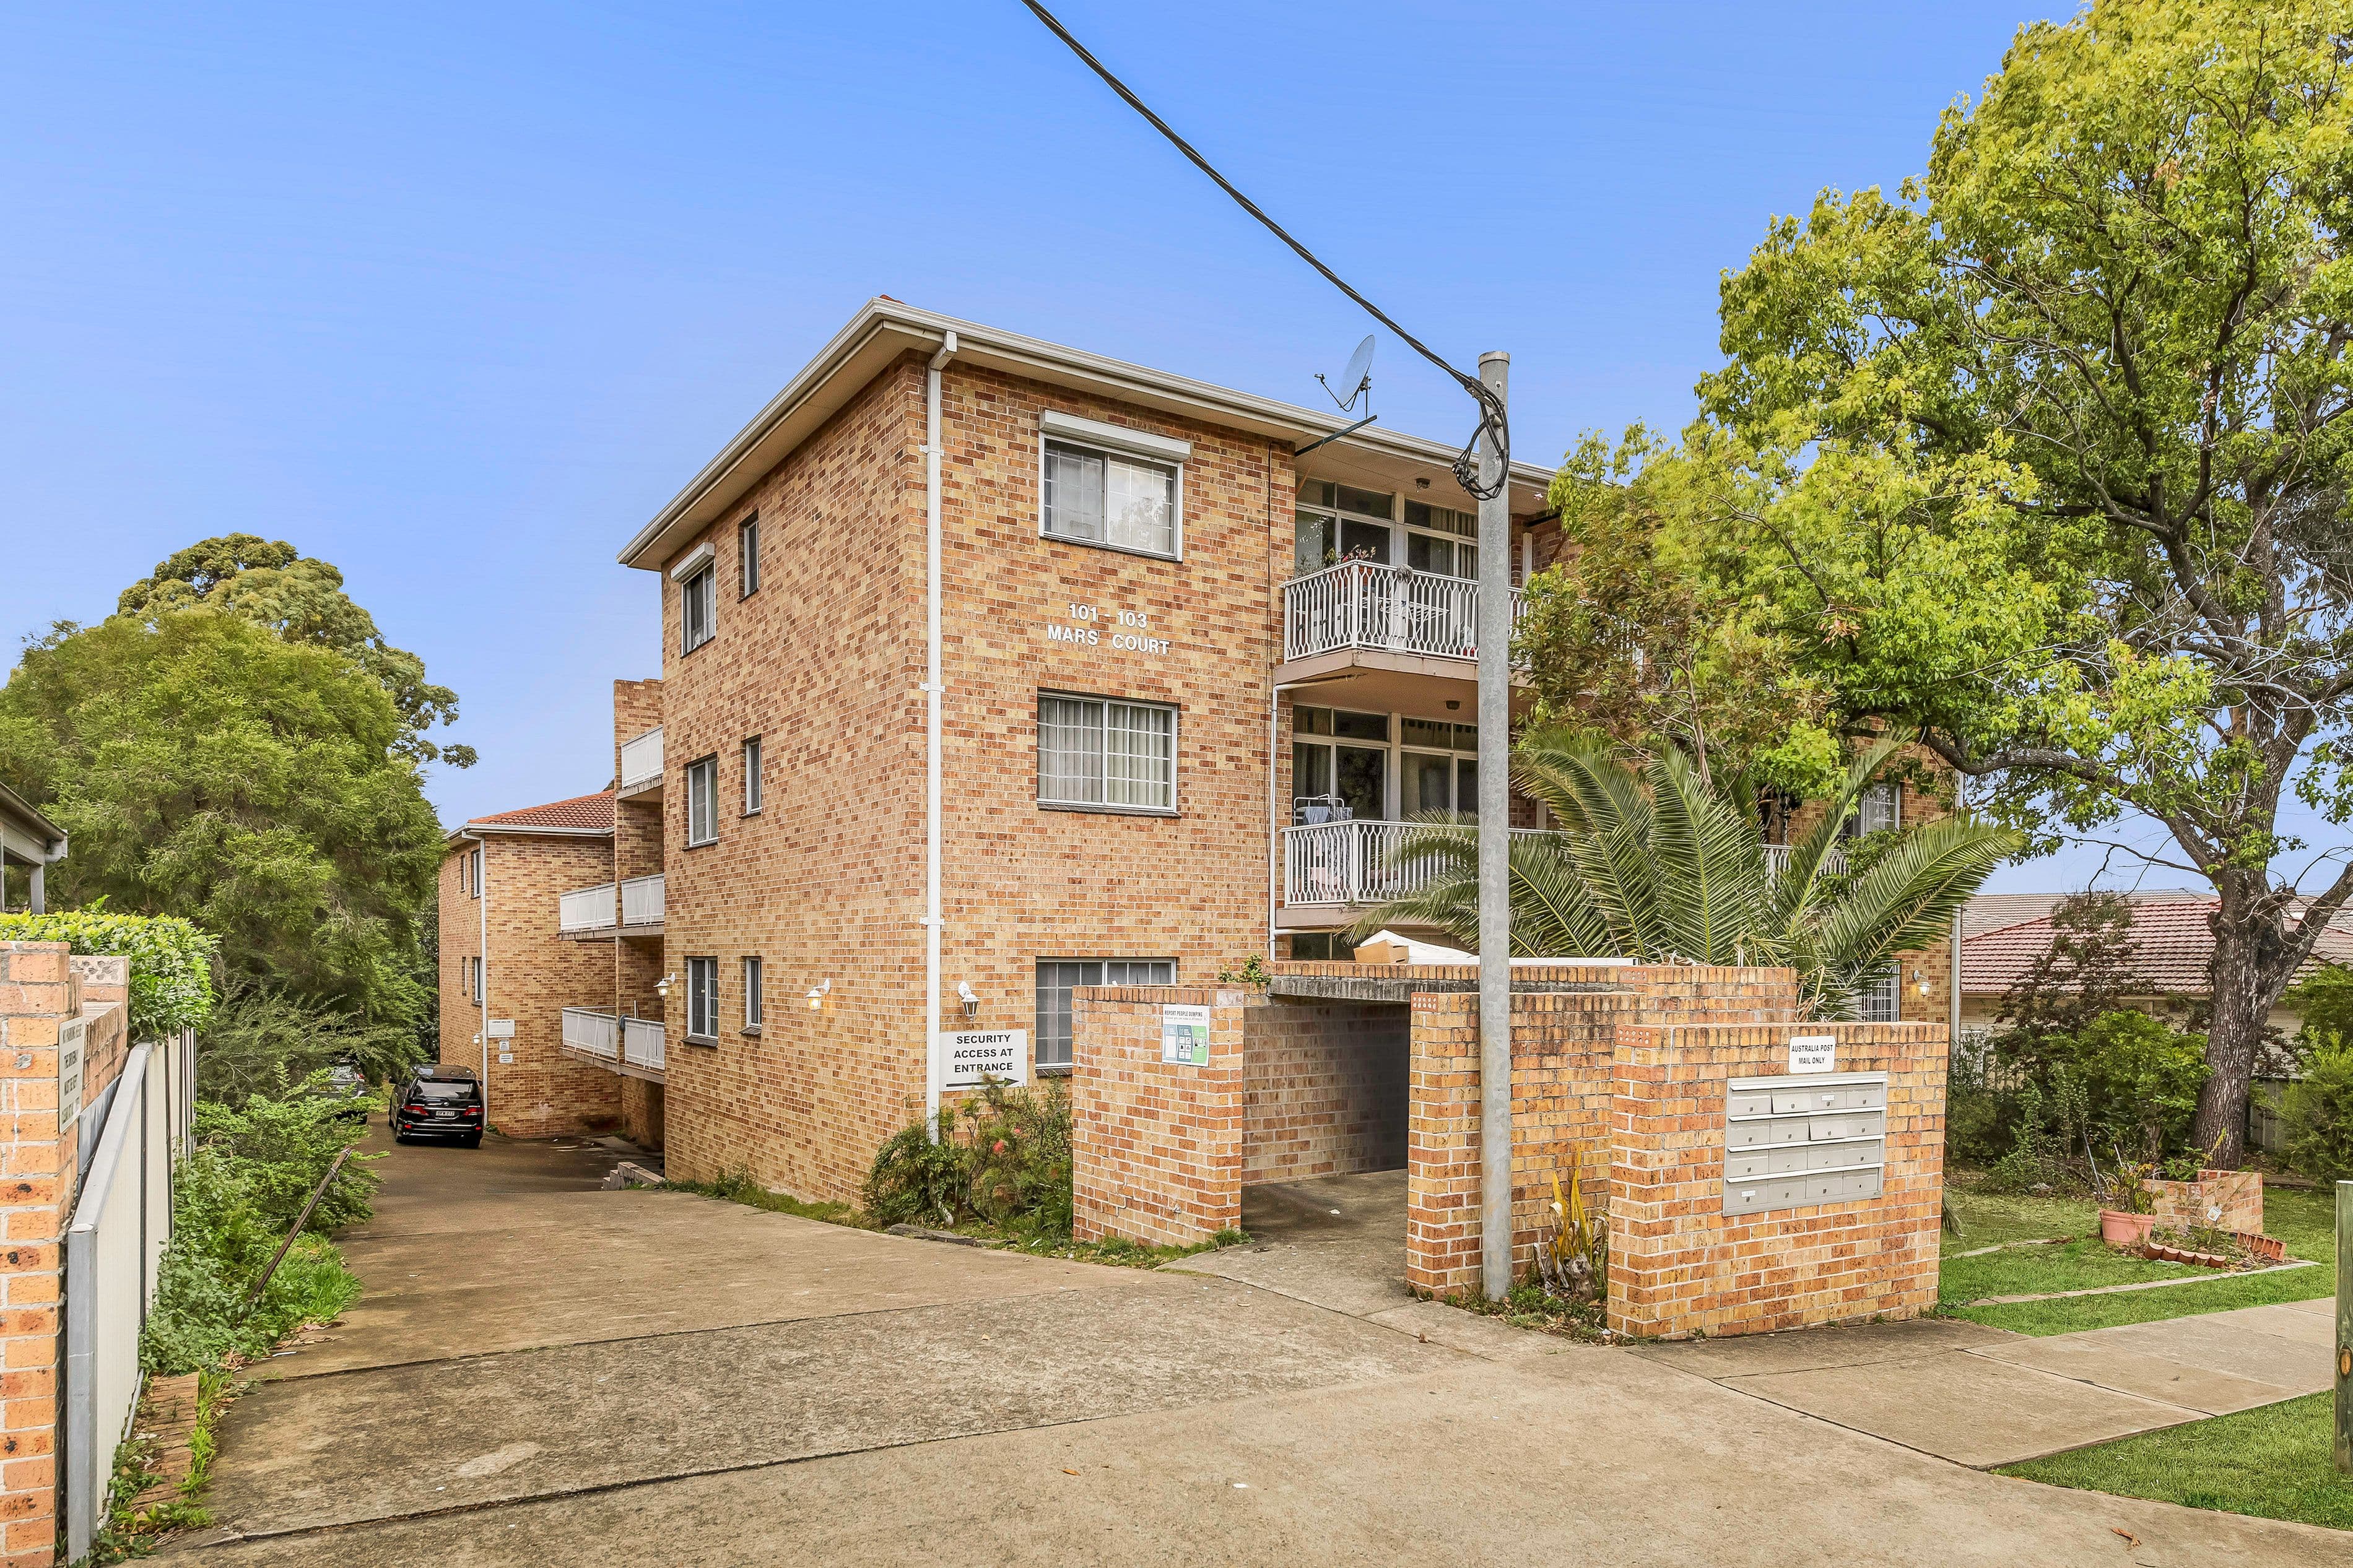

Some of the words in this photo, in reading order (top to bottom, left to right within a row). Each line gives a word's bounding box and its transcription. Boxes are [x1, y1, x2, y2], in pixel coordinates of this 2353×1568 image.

[1069, 603, 1097, 622] 101
[1117, 610, 1147, 628] 103
[1047, 625, 1098, 646] MARS
[1111, 634, 1170, 655] COURT
[956, 1034, 1011, 1044] SECURITY
[954, 1049, 996, 1059] ACCESS
[1000, 1049, 1013, 1057] AT
[954, 1062, 1013, 1073] ENTRANCE
